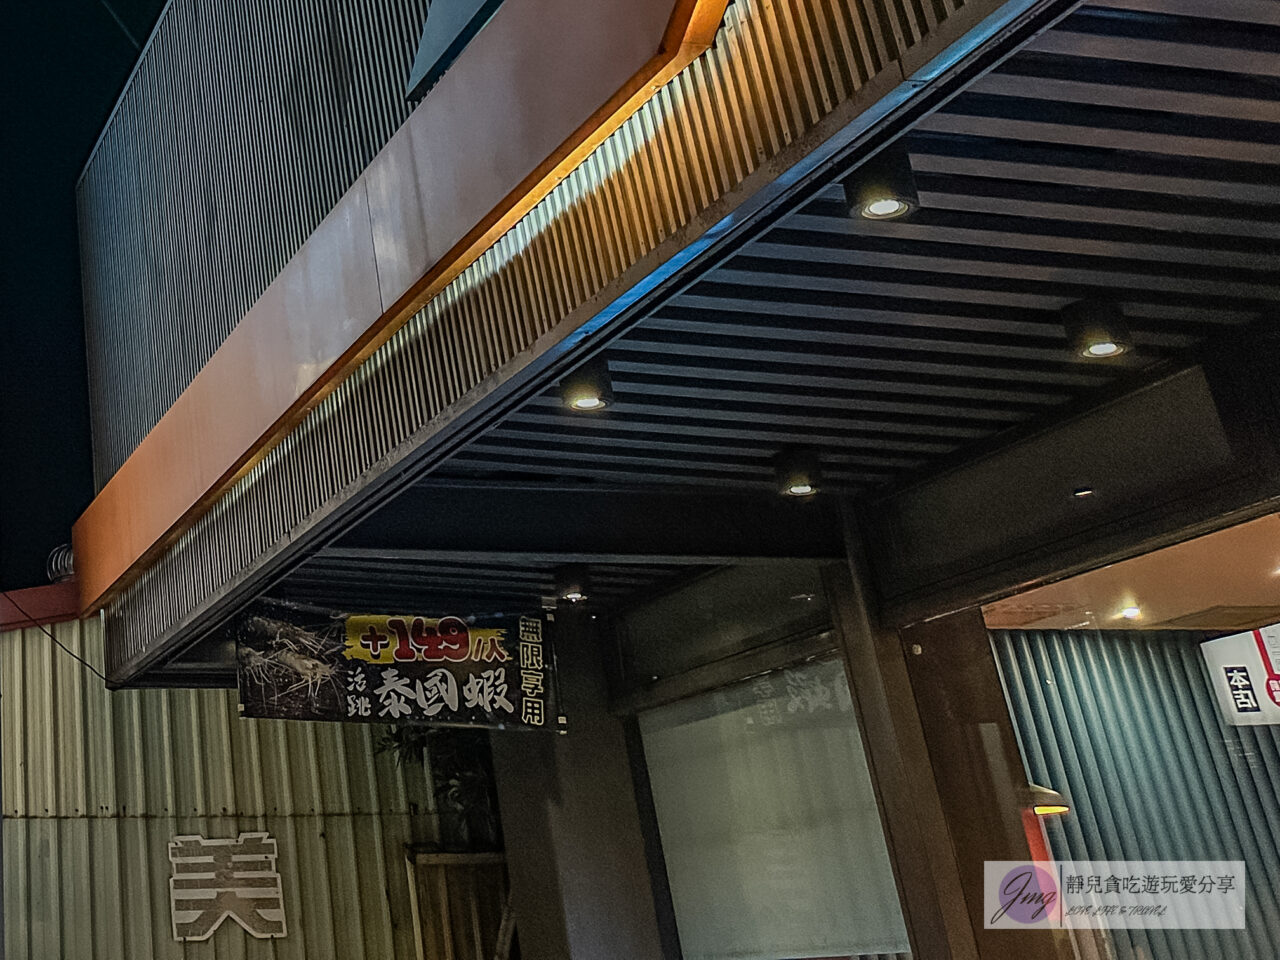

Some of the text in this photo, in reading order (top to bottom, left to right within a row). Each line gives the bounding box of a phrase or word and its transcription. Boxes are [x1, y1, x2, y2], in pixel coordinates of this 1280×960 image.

[373, 667, 514, 718] 泰國蝦
[519, 616, 545, 726] 無限享用
